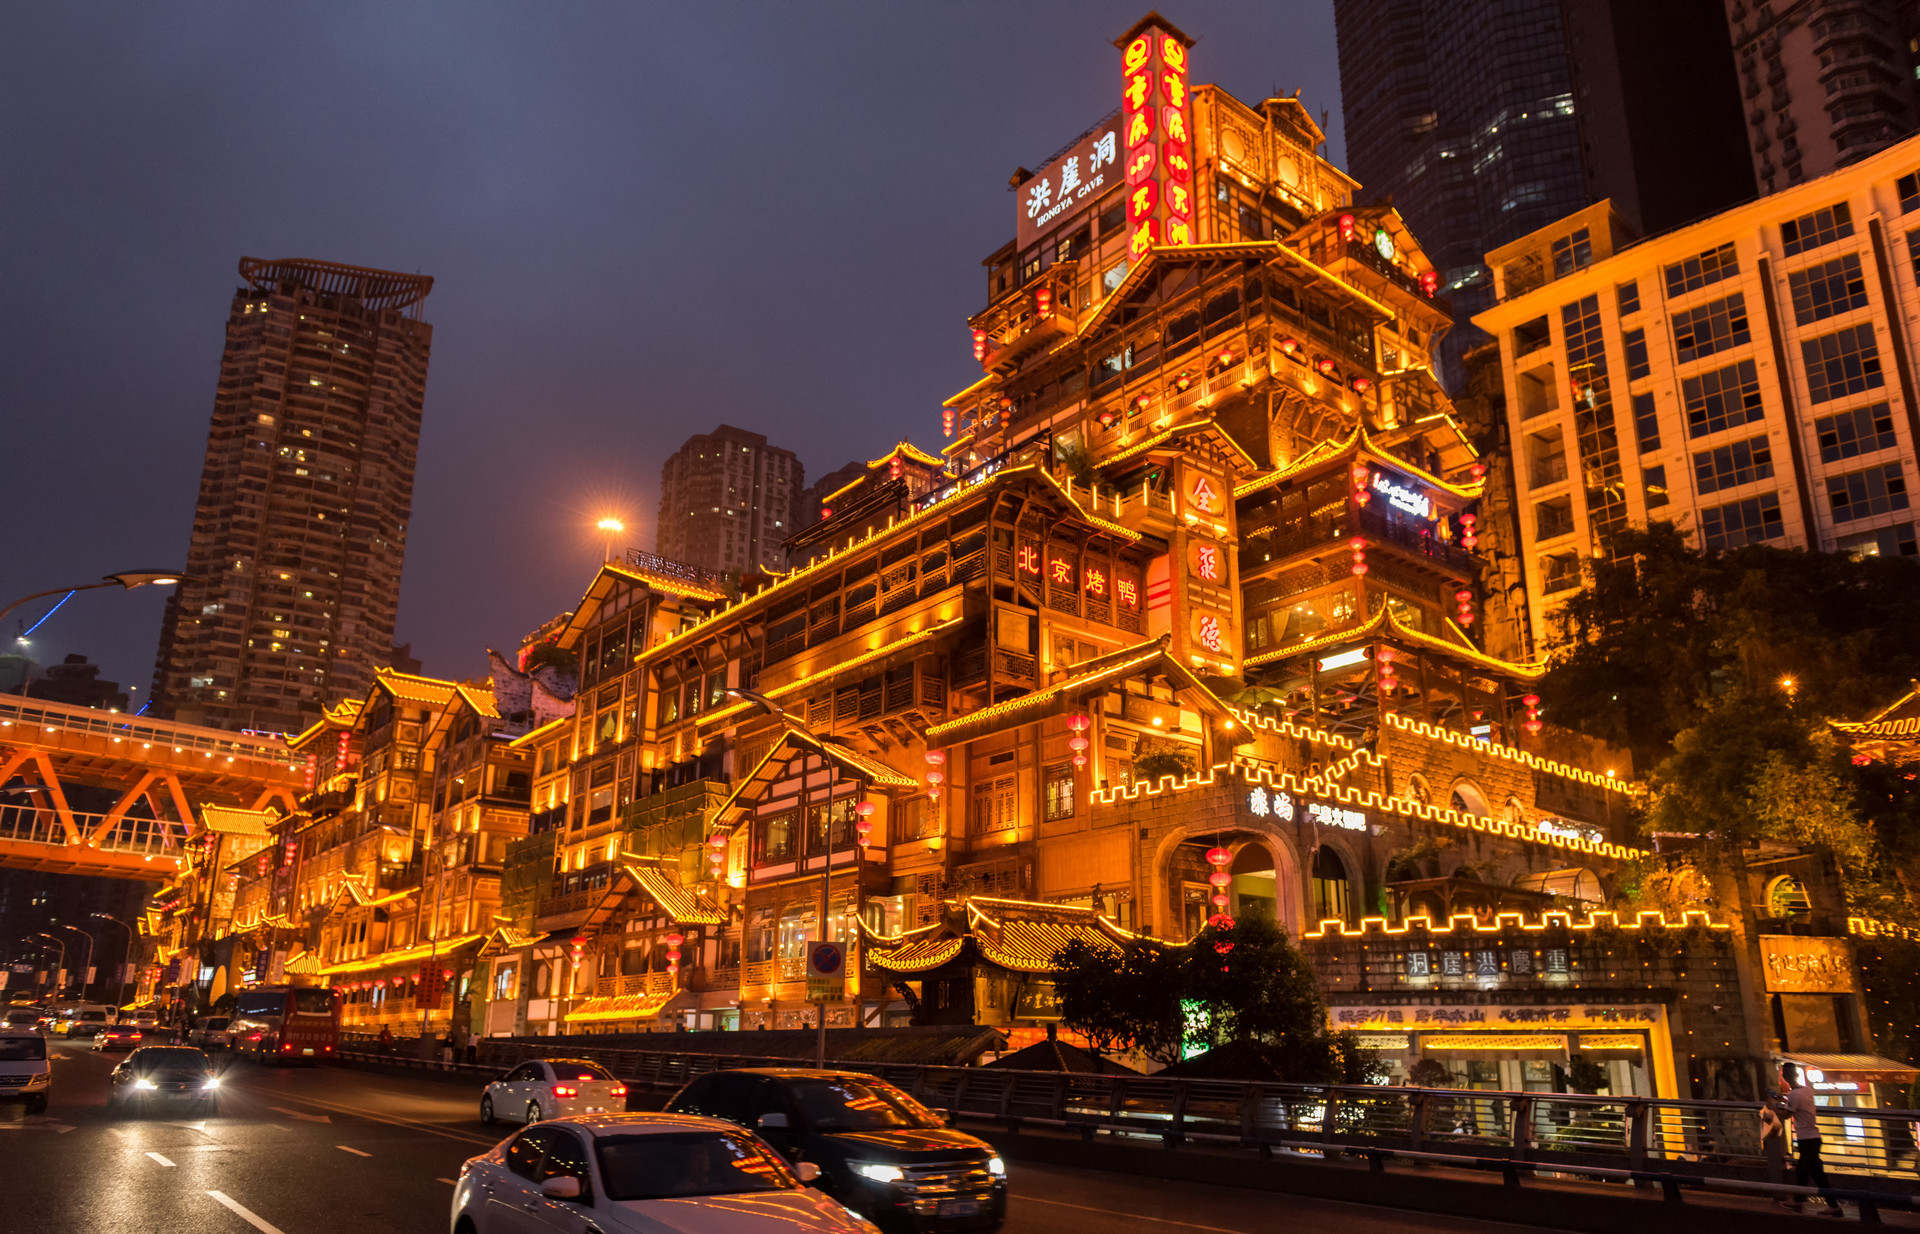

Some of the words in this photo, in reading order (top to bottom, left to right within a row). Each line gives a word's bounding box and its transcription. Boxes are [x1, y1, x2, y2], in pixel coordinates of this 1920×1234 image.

[1026, 131, 1116, 218] 洪崖洞
[1037, 196, 1073, 228] HONGYA
[1077, 173, 1104, 198] CAVE
[1018, 545, 1137, 606] 北京烤鸭
[1193, 477, 1222, 652] 全聚德
